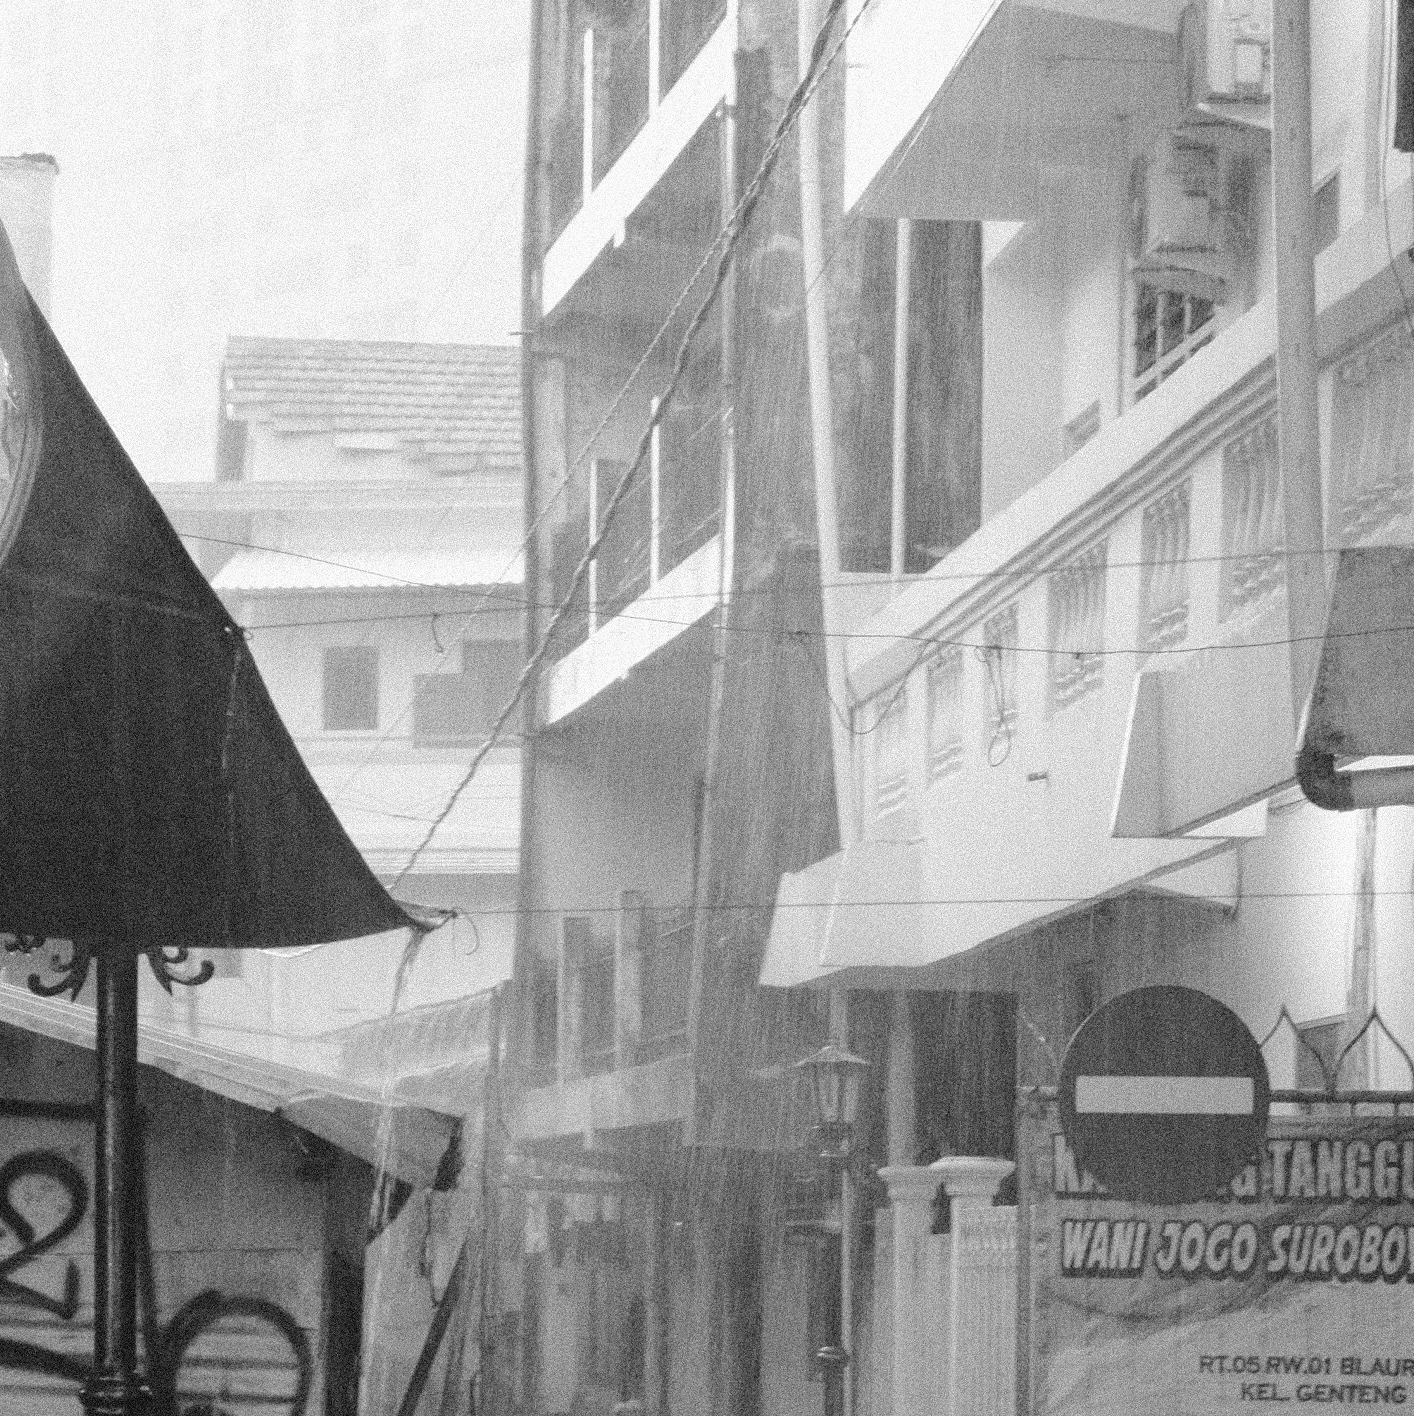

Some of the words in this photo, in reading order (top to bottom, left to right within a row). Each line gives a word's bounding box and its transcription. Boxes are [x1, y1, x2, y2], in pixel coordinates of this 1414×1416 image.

[1062, 1220, 1149, 1273] WANI
[1156, 1221, 1257, 1276] JOGO
[1199, 1354, 1261, 1374] RT.05
[1266, 1355, 1331, 1375] RW.01
[1296, 1384, 1407, 1404] GENTENG
